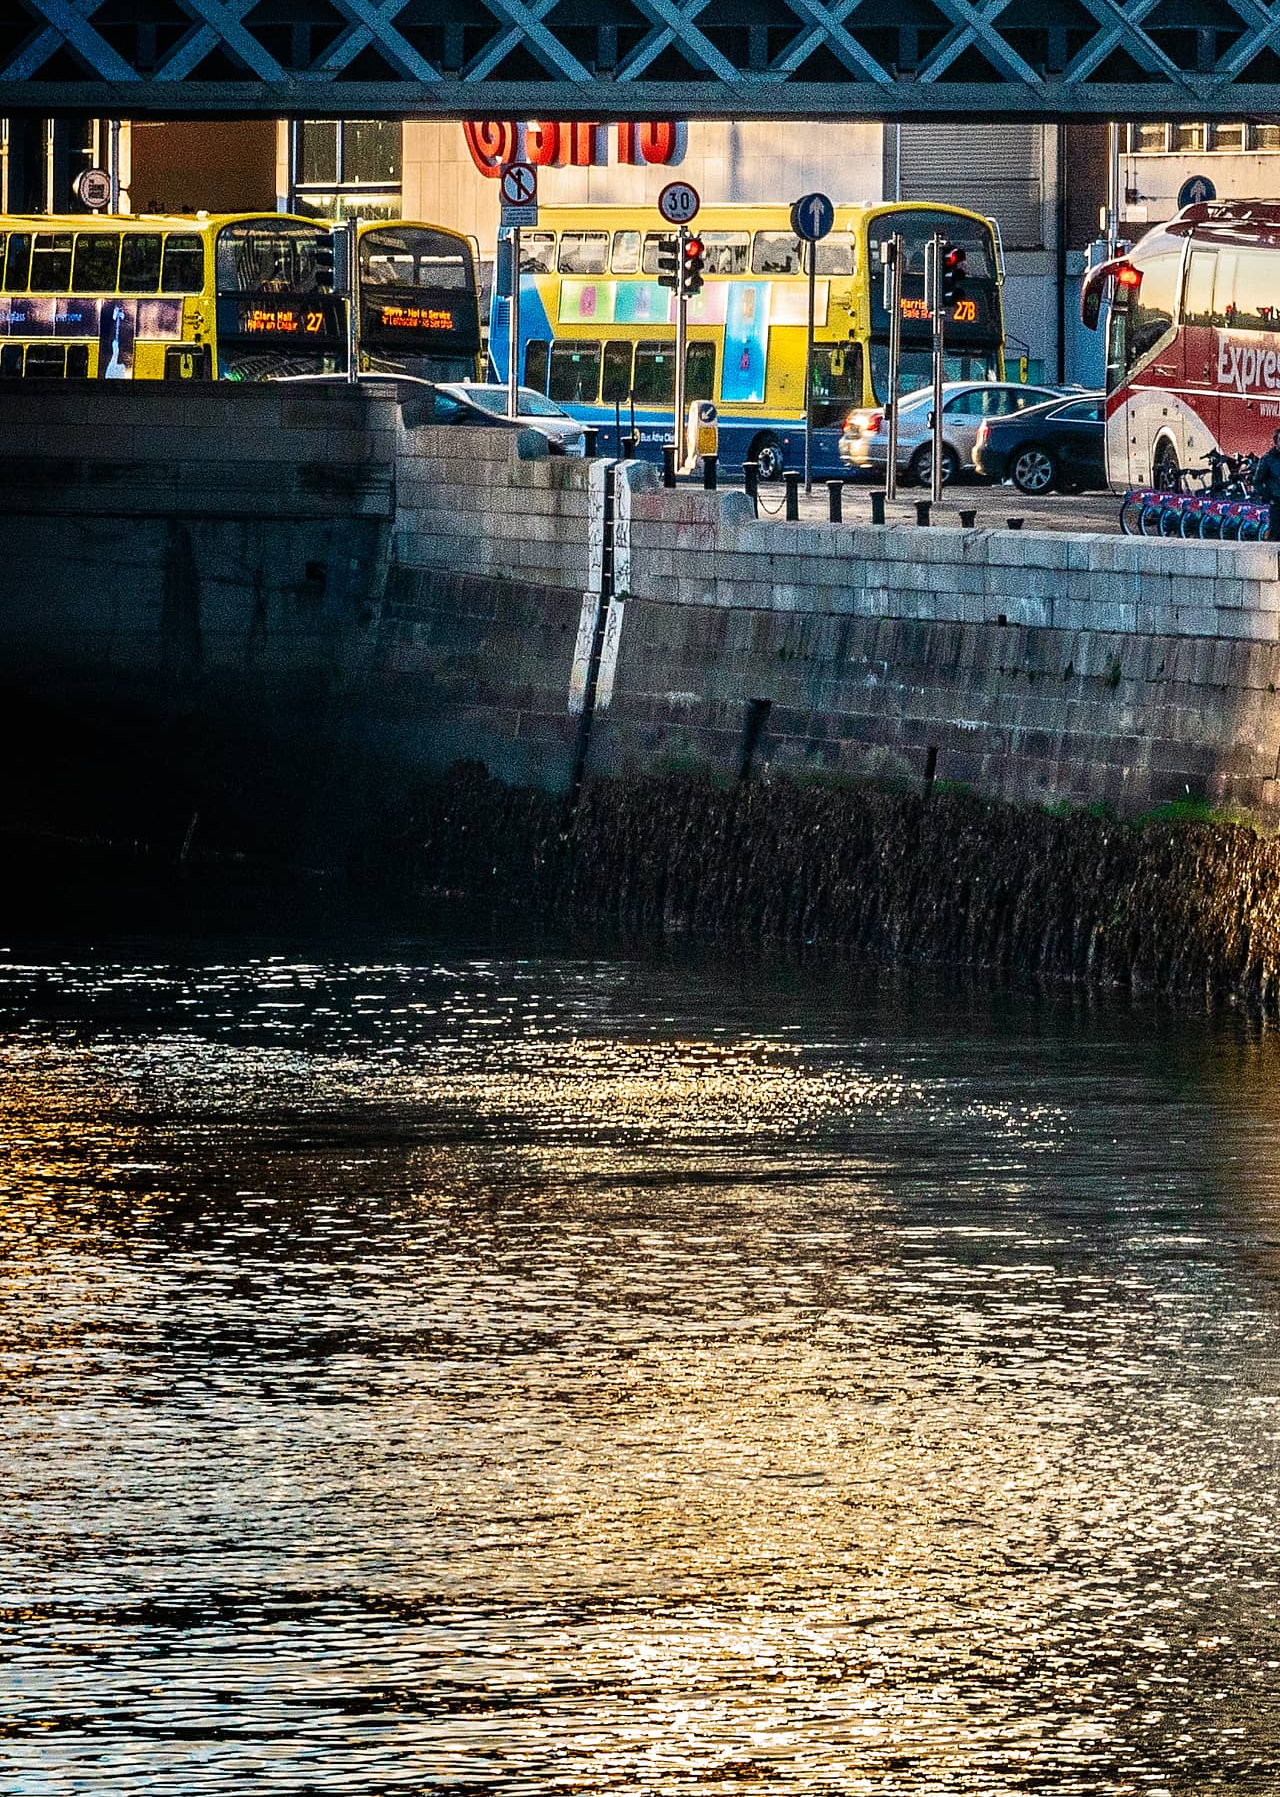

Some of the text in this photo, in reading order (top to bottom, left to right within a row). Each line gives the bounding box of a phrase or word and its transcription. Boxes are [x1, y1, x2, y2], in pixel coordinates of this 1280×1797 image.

[669, 192, 690, 211] 30
[953, 301, 976, 320] 27B
[306, 312, 323, 332] 27
